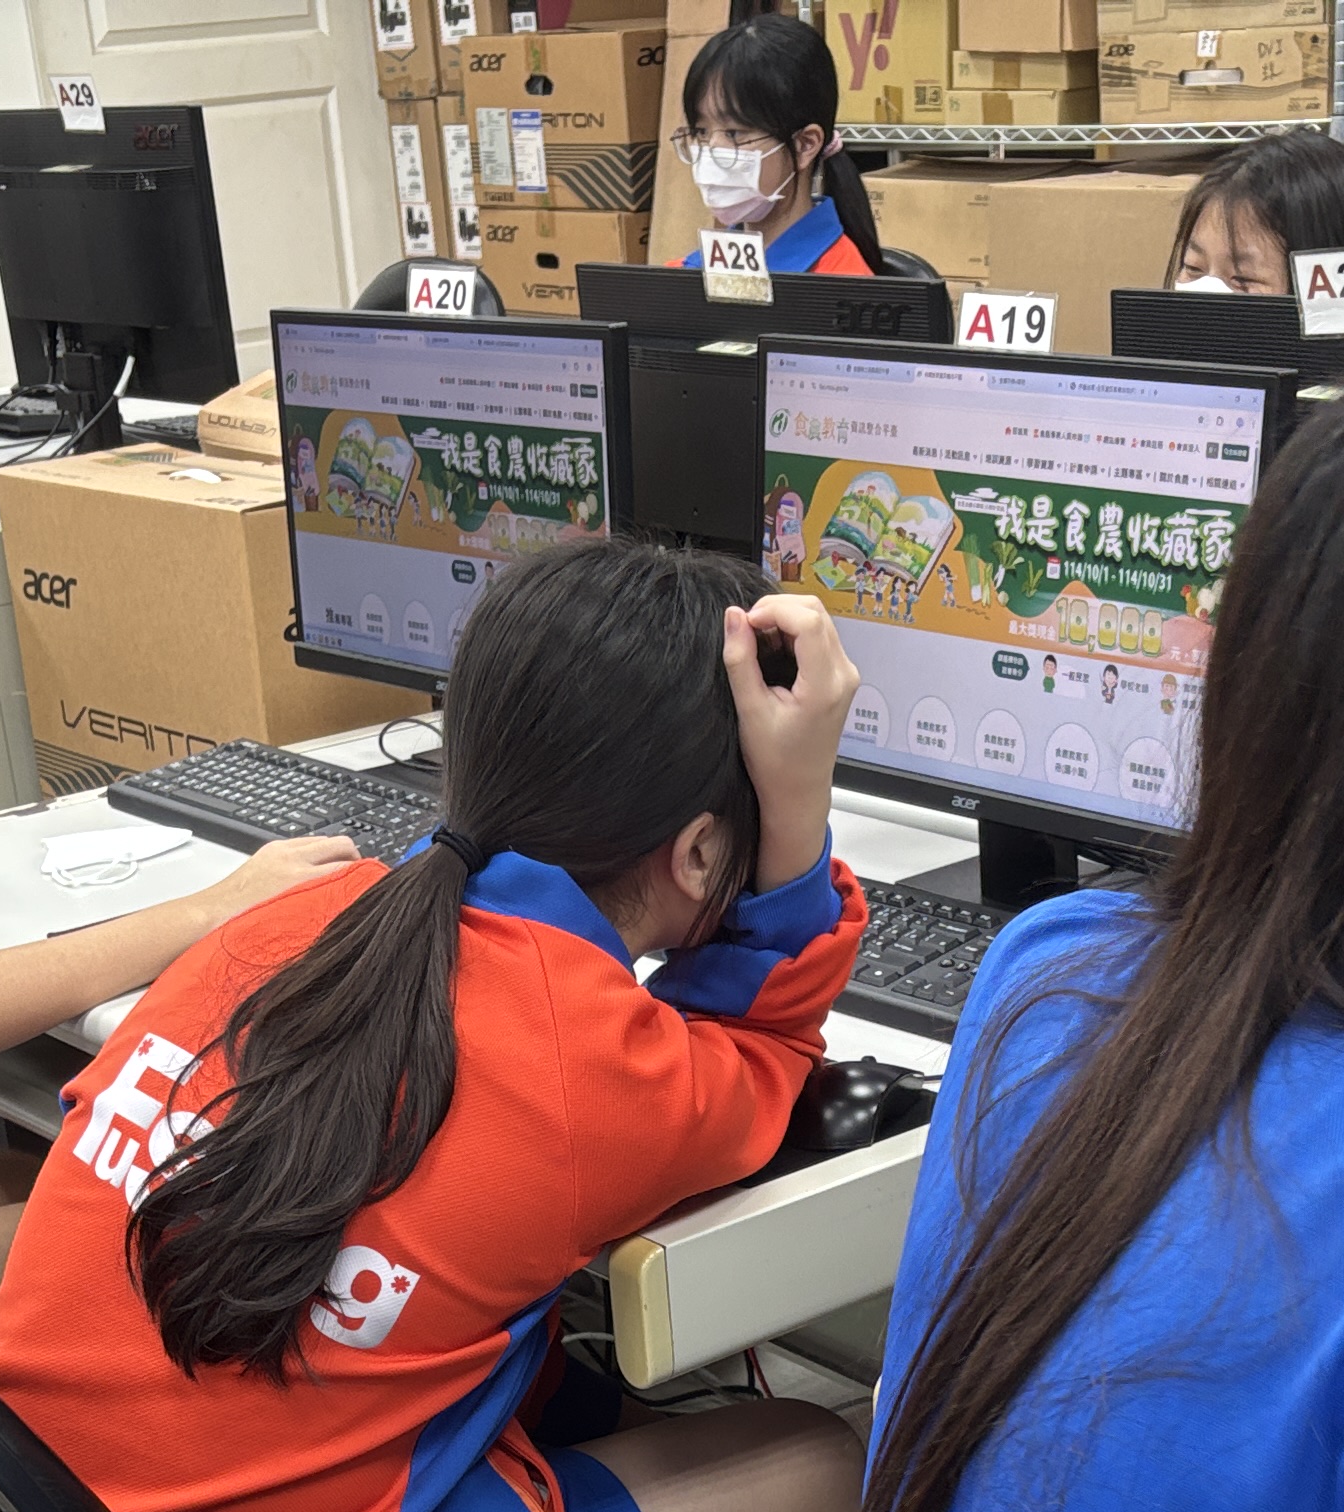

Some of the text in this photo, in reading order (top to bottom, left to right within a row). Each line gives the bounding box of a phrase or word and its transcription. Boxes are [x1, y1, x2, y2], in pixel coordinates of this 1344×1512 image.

[469, 53, 506, 72] acer
[58, 83, 95, 108] A29
[133, 122, 180, 150] acer
[540, 111, 605, 129] RITON
[486, 224, 519, 243] acer
[709, 238, 760, 271] A28
[413, 278, 467, 311] A20
[522, 282, 576, 300] VERIT
[965, 303, 1046, 344] A19
[794, 411, 848, 444] 食農教育
[441, 431, 599, 489] 我是食農收藏家
[994, 493, 1237, 572] 我是食農收藏家
[23, 567, 77, 609] acer
[1063, 560, 1173, 595] 114/10/1 114/10/31
[1056, 597, 1164, 658] 10,000
[951, 795, 980, 811] acer
